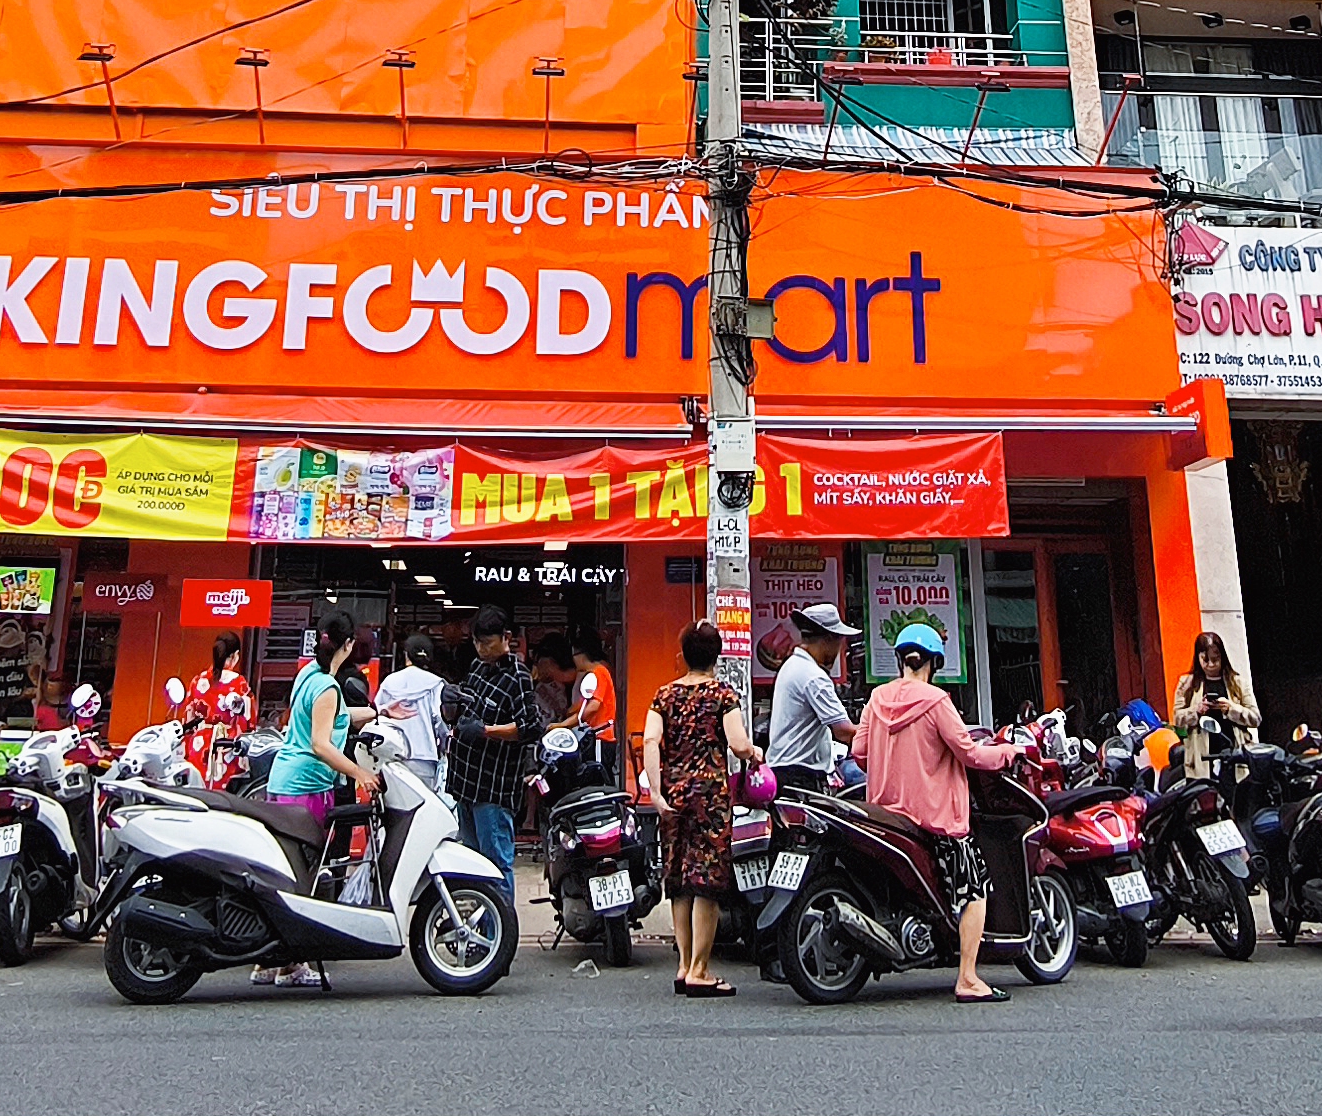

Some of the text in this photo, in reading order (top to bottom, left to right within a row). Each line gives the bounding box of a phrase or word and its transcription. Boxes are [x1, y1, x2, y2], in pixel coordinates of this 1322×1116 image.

[335, 185, 416, 231] THỊ
[431, 184, 567, 234] THỰC
[1238, 239, 1301, 272] CÔNG
[1174, 292, 1292, 336] SONG
[1193, 352, 1210, 364] 122
[1248, 354, 1265, 367] Chợ
[116, 469, 132, 479] ÁP
[134, 472, 165, 482] DỤNG
[167, 472, 191, 482] CHO
[814, 472, 886, 487] COCKTAIL,
[889, 470, 930, 486] NƯỚC
[933, 469, 964, 489] GIẶT
[118, 483, 136, 494] GIÁ
[139, 486, 155, 497] TRỊ
[158, 487, 182, 496] MUA
[461, 470, 572, 527] MUA
[590, 469, 612, 521] 1
[780, 463, 802, 516] 1
[814, 489, 840, 504] MÍT
[876, 489, 917, 504] KHĂN
[476, 567, 513, 582] RAU
[517, 567, 530, 582] &
[536, 564, 576, 583] TRÁI
[96, 583, 136, 605] envy
[763, 579, 824, 594] THỊT HEO
[207, 590, 244, 605] meiji
